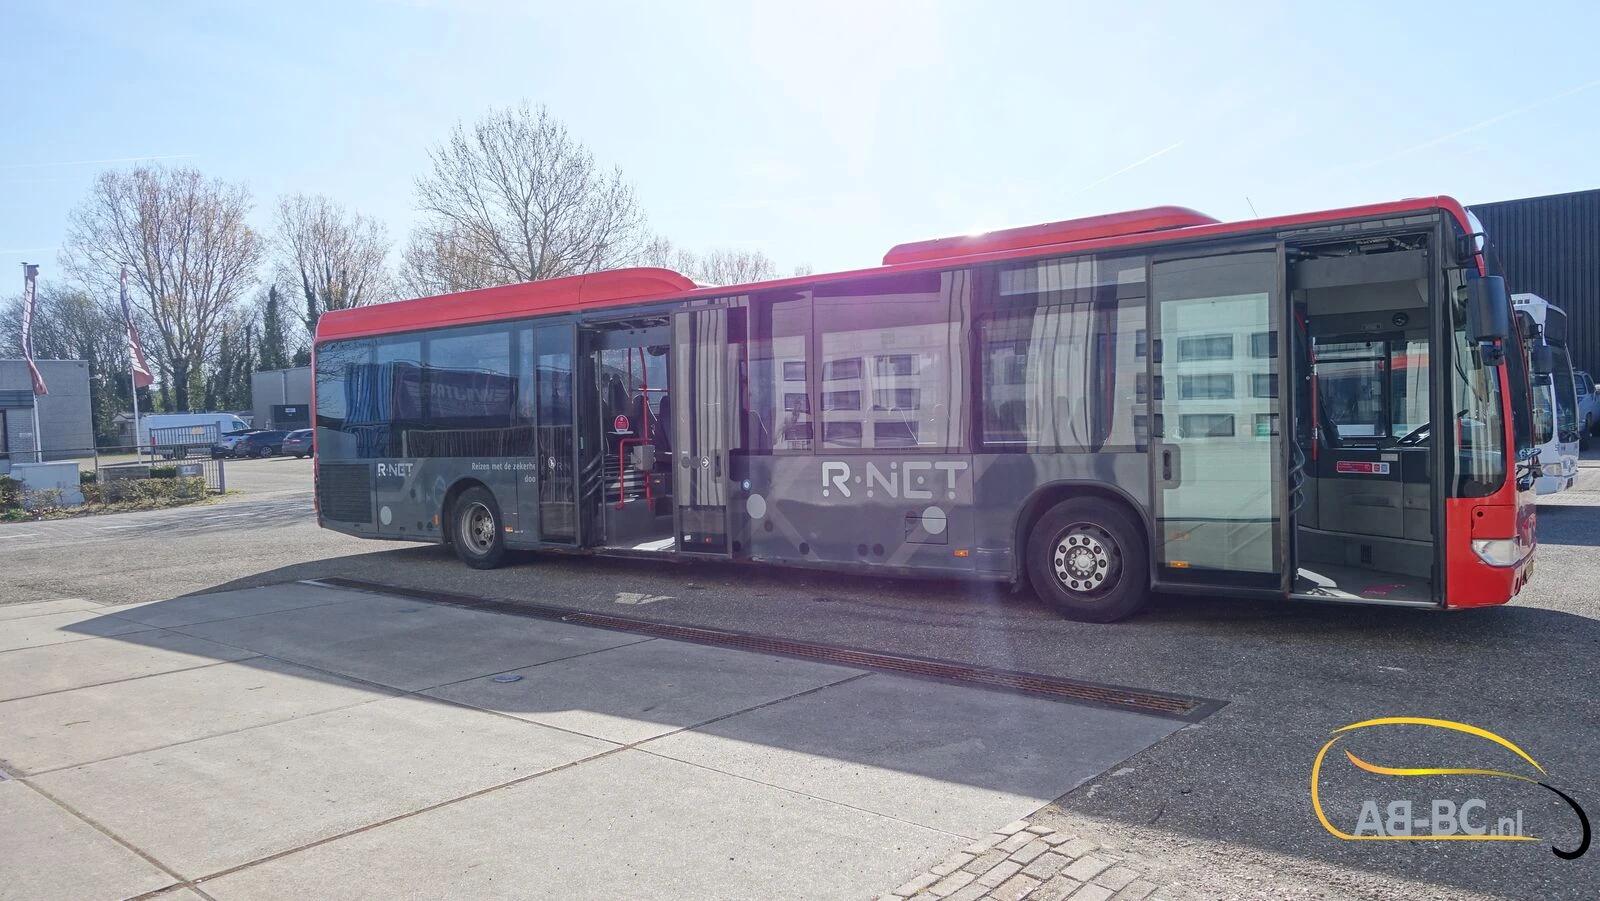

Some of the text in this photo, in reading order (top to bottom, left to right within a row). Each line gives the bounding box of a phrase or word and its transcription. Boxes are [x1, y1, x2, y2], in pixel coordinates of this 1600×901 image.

[471, 461, 490, 470] Reizen
[491, 462, 503, 470] met
[503, 461, 512, 470] de
